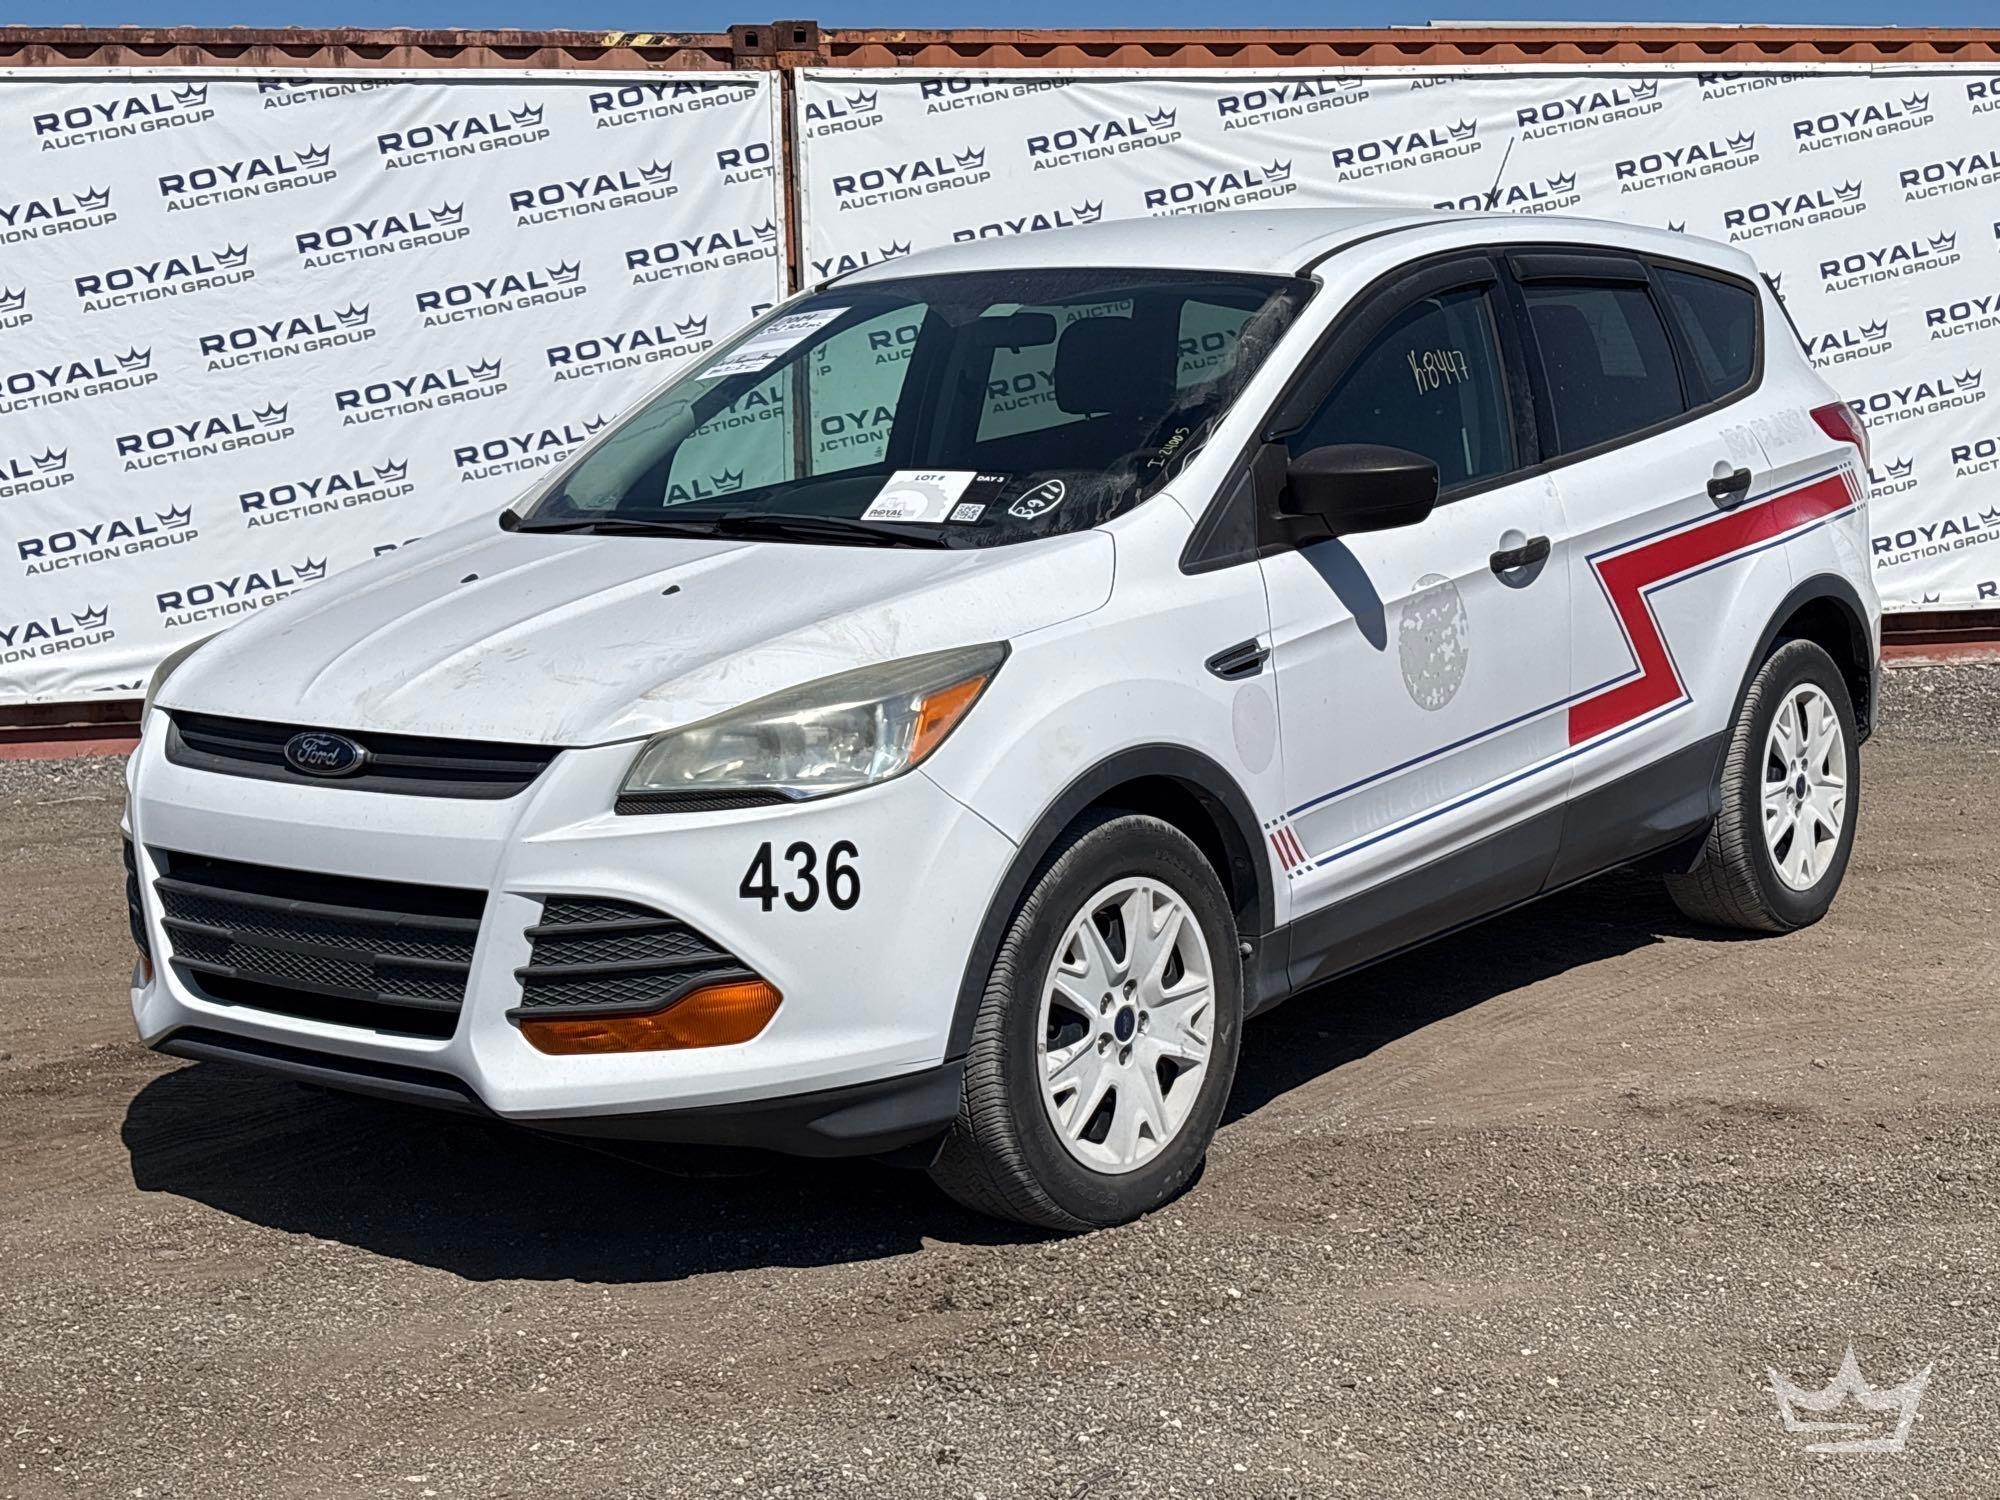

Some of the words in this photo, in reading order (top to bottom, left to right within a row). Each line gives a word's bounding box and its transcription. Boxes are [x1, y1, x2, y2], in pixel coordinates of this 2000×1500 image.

[263, 83, 357, 109] AUCTION
[597, 103, 684, 128] AUCTION
[688, 89, 755, 110] GROUP
[927, 89, 1009, 114] AUCTION
[1218, 78, 1336, 116] ROYAL
[1517, 89, 1630, 127] ROYAL
[1702, 77, 1777, 101] AUCTION
[33, 94, 174, 135] ROYAL
[42, 124, 136, 151] AUCTION
[141, 110, 214, 132] GROUP
[818, 115, 882, 136] GROUP
[1224, 106, 1302, 131] AUCTION
[1307, 91, 1369, 112] GROUP
[1523, 116, 1598, 141] AUCTION
[1603, 102, 1662, 123] GROUP
[1794, 102, 1902, 139] ROYAL
[377, 114, 511, 154] ROYAL
[386, 144, 475, 170] AUCTION
[480, 129, 549, 151] GROUP
[1027, 118, 1147, 156] ROYAL
[1034, 146, 1114, 170] AUCTION
[1118, 132, 1181, 152] GROUP
[1332, 130, 1448, 168] ROYAL
[1799, 129, 1872, 153] AUCTION
[1876, 115, 1933, 135] GROUP
[159, 155, 297, 196] ROYAL
[723, 166, 773, 185] AUCT
[833, 158, 955, 196] ROYAL
[1339, 157, 1416, 182] AUCTION
[1420, 142, 1481, 163] GROUP
[1616, 142, 1727, 180] ROYAL
[1621, 168, 1696, 194] AUCTION
[1700, 154, 1759, 175] GROUP
[1900, 151, 2000, 188] ROYAL
[167, 185, 260, 212] AUCTION
[264, 170, 336, 193] GROUP
[510, 171, 640, 211] ROYAL
[518, 200, 605, 226] AUCTION
[610, 186, 678, 208] GROUP
[840, 186, 922, 211] AUCTION
[926, 172, 990, 192] GROUP
[1144, 170, 1262, 209] ROYAL
[1234, 184, 1296, 204] GROUP
[1906, 178, 1978, 202] AUCTION
[0, 198, 76, 226] YAL
[42, 213, 116, 236] GROUP
[1724, 191, 1834, 228] ROYAL
[1730, 218, 1804, 242] AUCTION
[1808, 203, 1866, 224] GROUP
[296, 213, 431, 254] ROYAL
[304, 242, 394, 269] AUCTION
[399, 228, 470, 250] GROUP
[626, 229, 753, 270] ROYAL
[75, 255, 214, 297] ROYAL
[633, 258, 718, 285] AUCTION
[723, 246, 777, 267] GROU
[1820, 242, 1929, 279] ROYAL
[1826, 268, 1899, 293] AUCTION
[1903, 254, 1960, 274] GROUP
[84, 285, 177, 312] AUCTION
[182, 270, 254, 293] GROUP
[416, 271, 548, 312] ROYAL
[424, 301, 512, 328] AUCTION
[517, 286, 586, 308] GROUP
[1066, 301, 1130, 322] AUCTIO
[200, 314, 336, 356] ROYAL
[208, 344, 299, 372] AUCTION
[304, 329, 376, 352] GROUP
[547, 326, 676, 367] ROYAL
[1802, 330, 1860, 356] YAL
[1834, 342, 1892, 363] GROUP
[0, 358, 117, 397] OYAL
[554, 355, 641, 382] AUCTION
[646, 340, 713, 362] GROUP
[0, 389, 79, 414] UCTION
[84, 373, 158, 396] GROUP
[335, 369, 469, 411] ROYAL
[988, 368, 1055, 399] ROY
[1928, 392, 1985, 412] GROUP
[344, 399, 433, 426] AUCTION
[438, 384, 507, 406] GROUP
[821, 406, 894, 435] OYA
[116, 414, 254, 456] ROYAL
[125, 444, 217, 472] AUCTION
[222, 428, 294, 451] GROUP
[454, 426, 585, 467] ROYAL
[0, 474, 74, 497] GROUP
[462, 455, 550, 482] AUCTION
[1956, 459, 1998, 477] AUCT
[240, 470, 375, 513] ROYAL
[248, 500, 338, 528] AUCTION
[343, 484, 414, 507] GROUP
[1868, 479, 1918, 499] ROUP
[18, 517, 158, 560] ROYAL
[26, 547, 120, 576] AUCTION
[125, 530, 198, 554] GROUP
[1872, 516, 1980, 555] ROYAL
[1878, 543, 1950, 568] AUCTION
[1954, 530, 1999, 548] GROU
[156, 569, 294, 613] ROYAL
[0, 617, 74, 646] YAL
[165, 599, 257, 628] AUCTION
[41, 630, 114, 654] GROUP
[297, 737, 340, 766] Ford
[739, 840, 861, 912] 436
